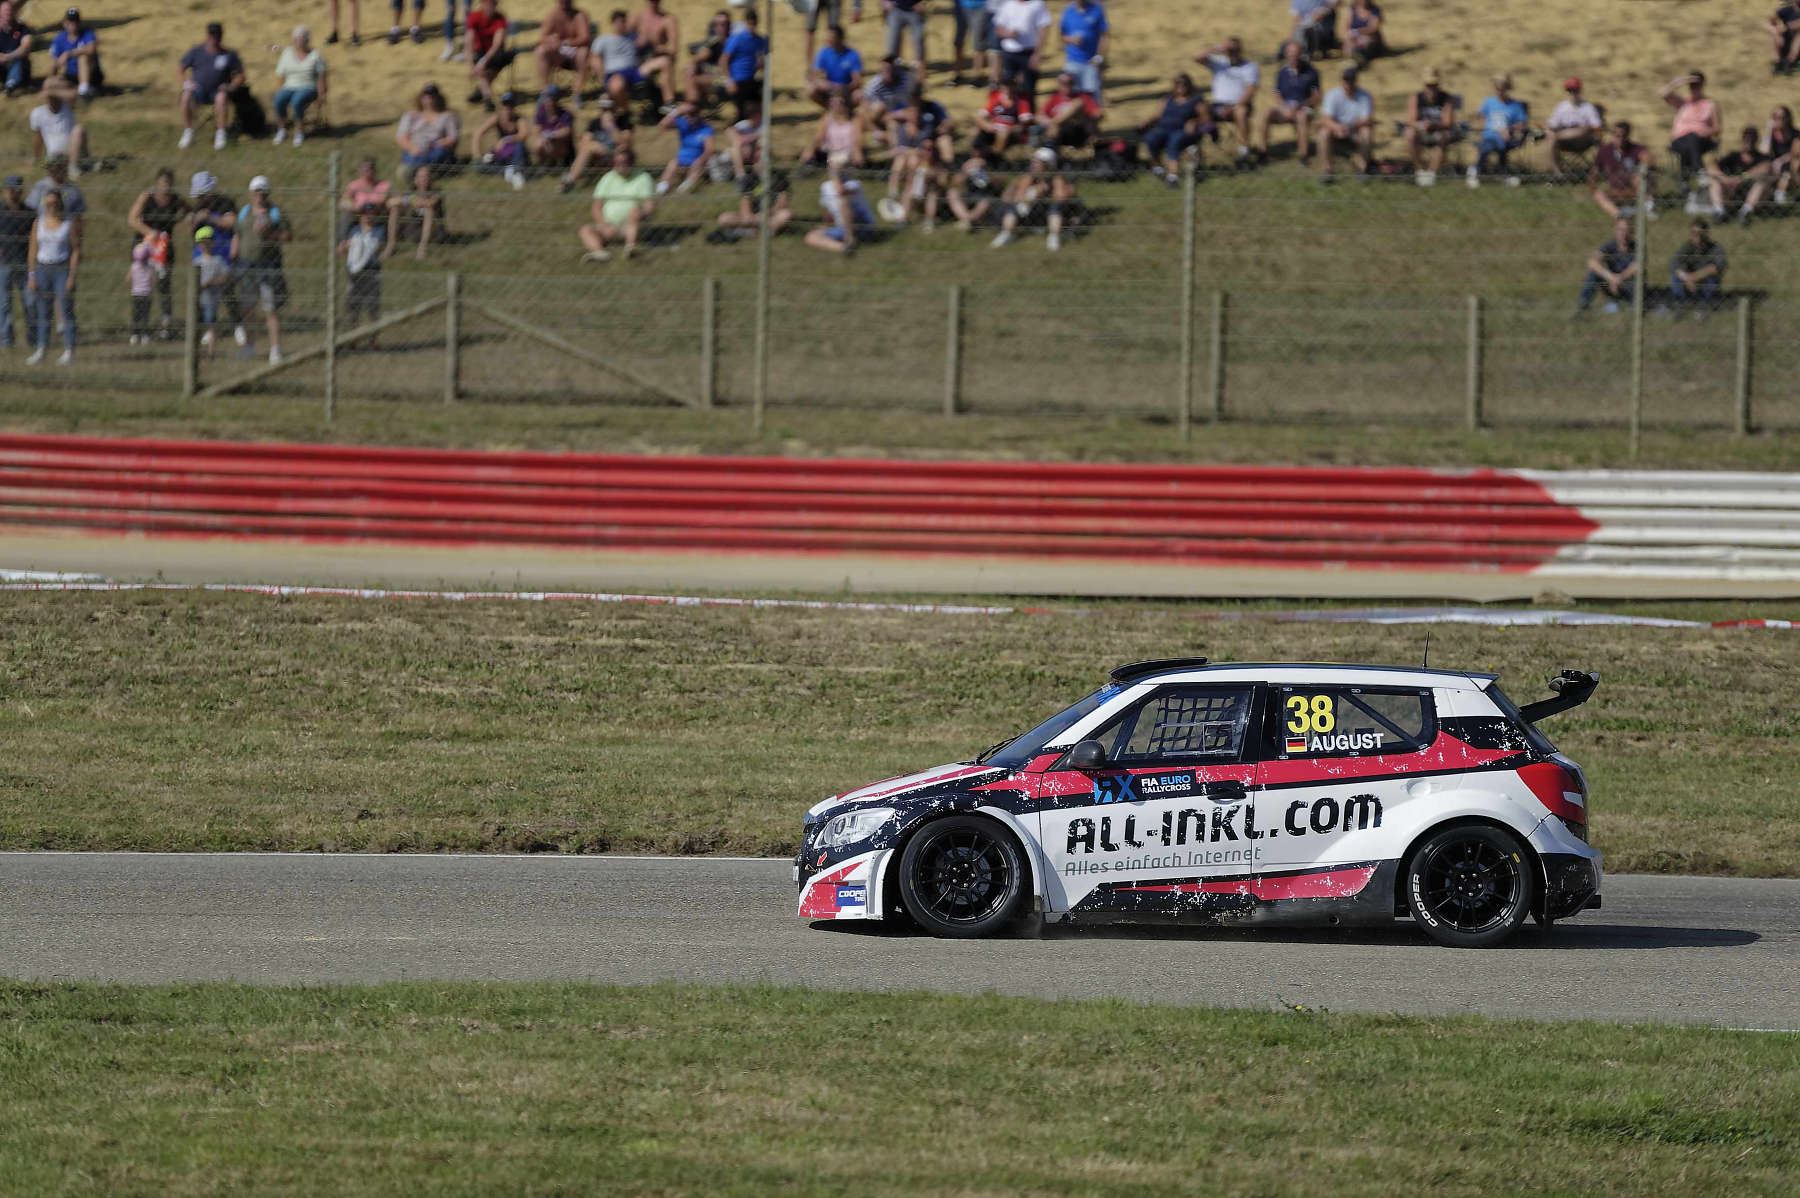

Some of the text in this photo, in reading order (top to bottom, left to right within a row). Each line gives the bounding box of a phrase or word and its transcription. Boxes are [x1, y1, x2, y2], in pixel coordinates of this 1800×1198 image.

[1287, 695, 1335, 734] 38
[1310, 733, 1384, 752] AUGUST
[1141, 775, 1191, 787] FIA EURO
[1141, 783, 1191, 794] RALLYCROSS
[1064, 847, 1262, 876] Alles einfach Internet
[1413, 873, 1438, 928] COOPER
